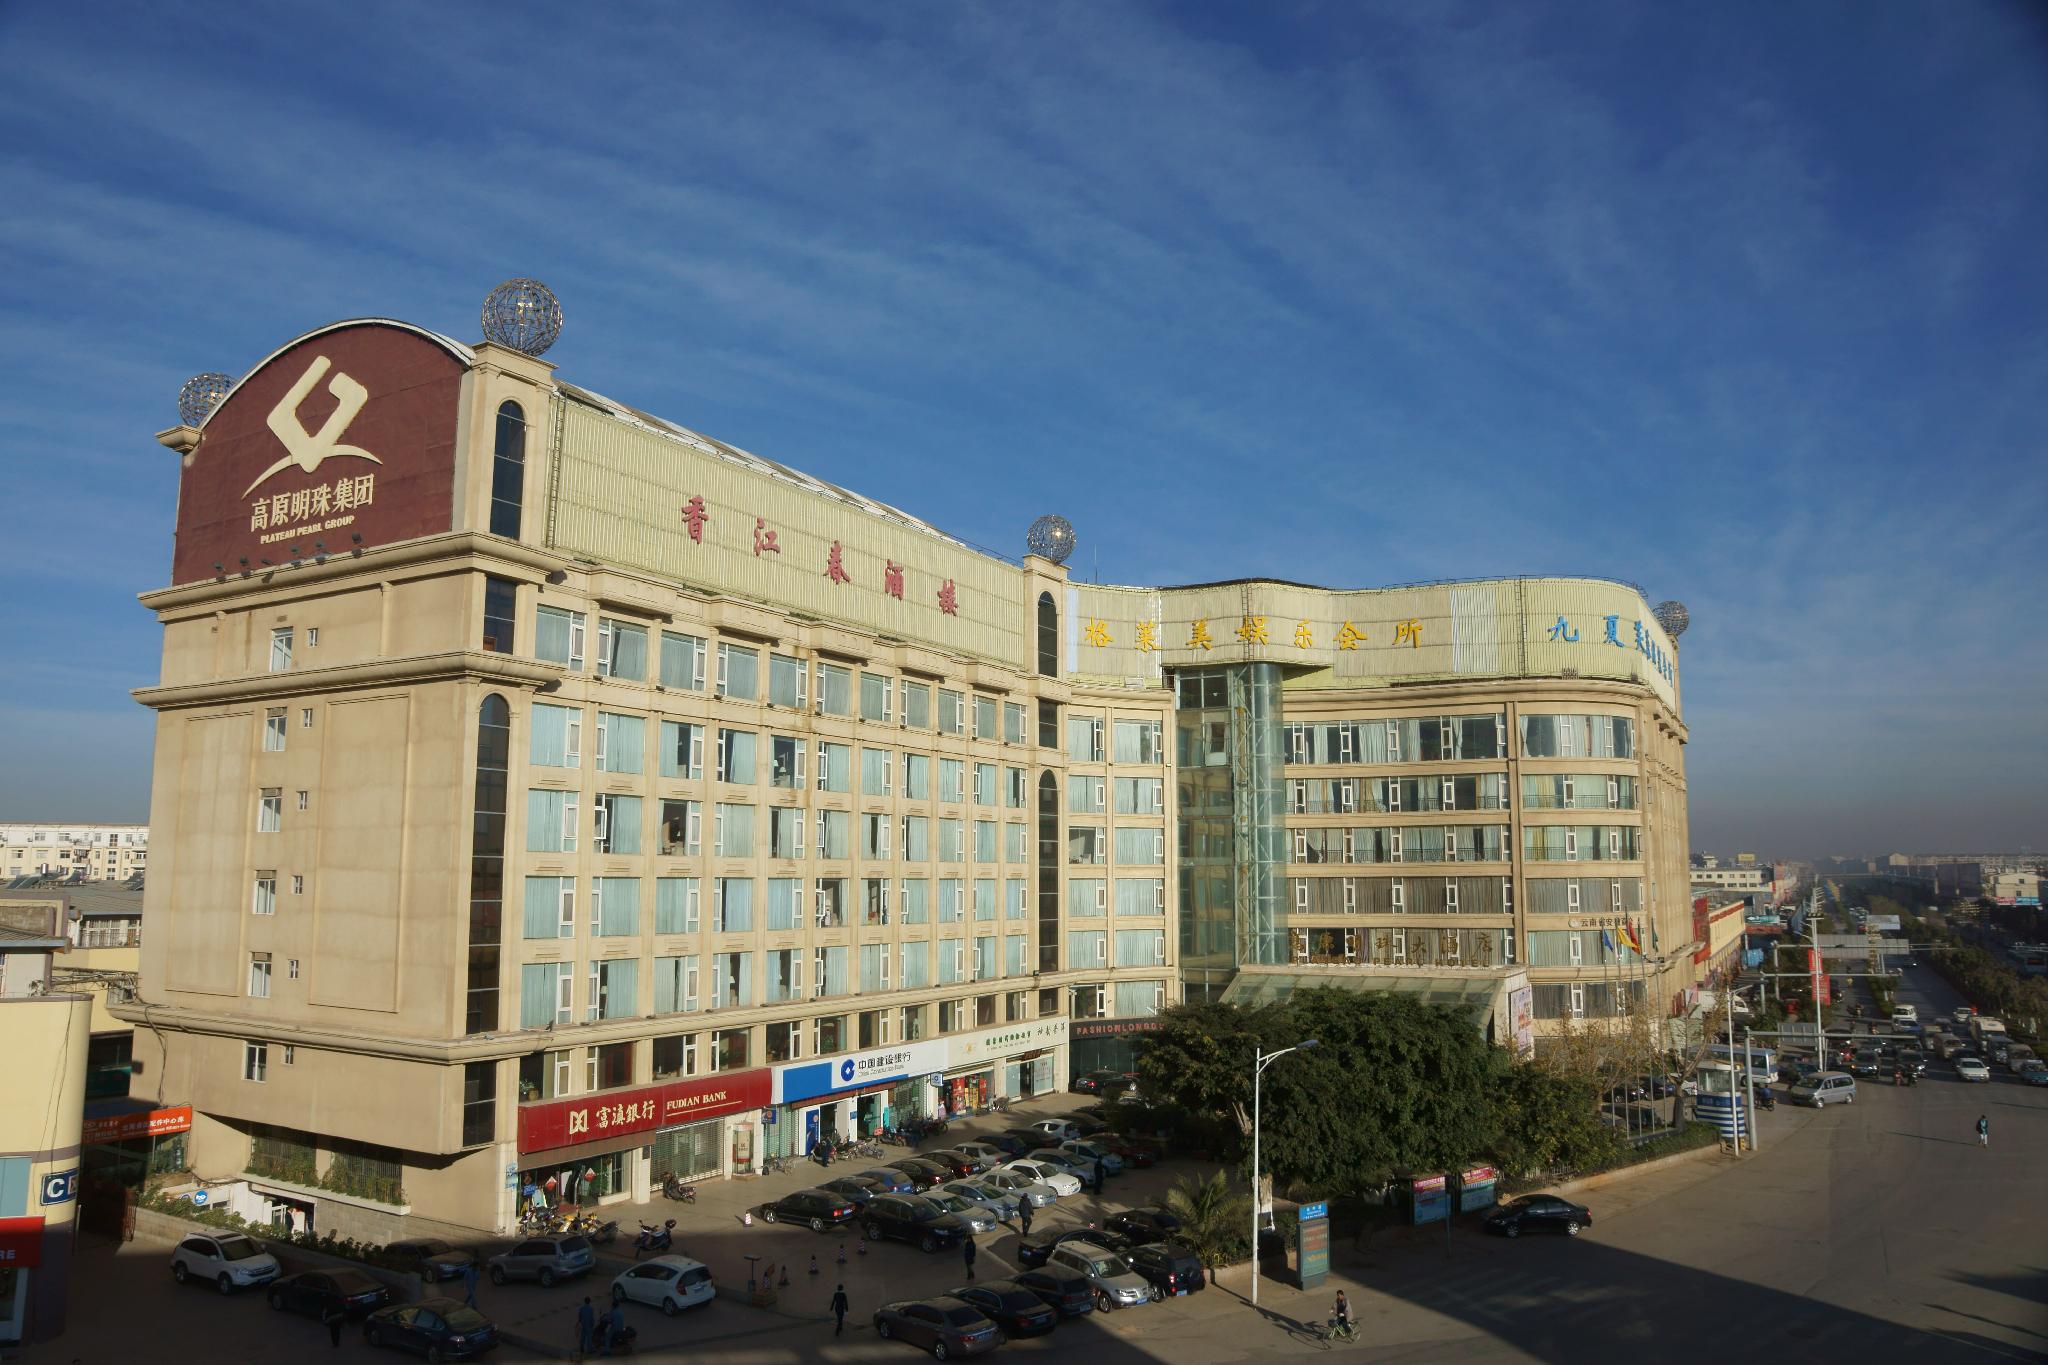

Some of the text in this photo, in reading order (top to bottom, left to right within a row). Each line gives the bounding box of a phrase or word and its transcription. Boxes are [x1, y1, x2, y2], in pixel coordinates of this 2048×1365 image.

[250, 473, 375, 532] 高原明珠集团
[260, 515, 355, 544] PLATEAU PEARL GROUP
[1085, 616, 1424, 653] 格莱美娱乐会所
[858, 1051, 911, 1070] 中国建设银行
[666, 1091, 727, 1110] FUDIAN BANK
